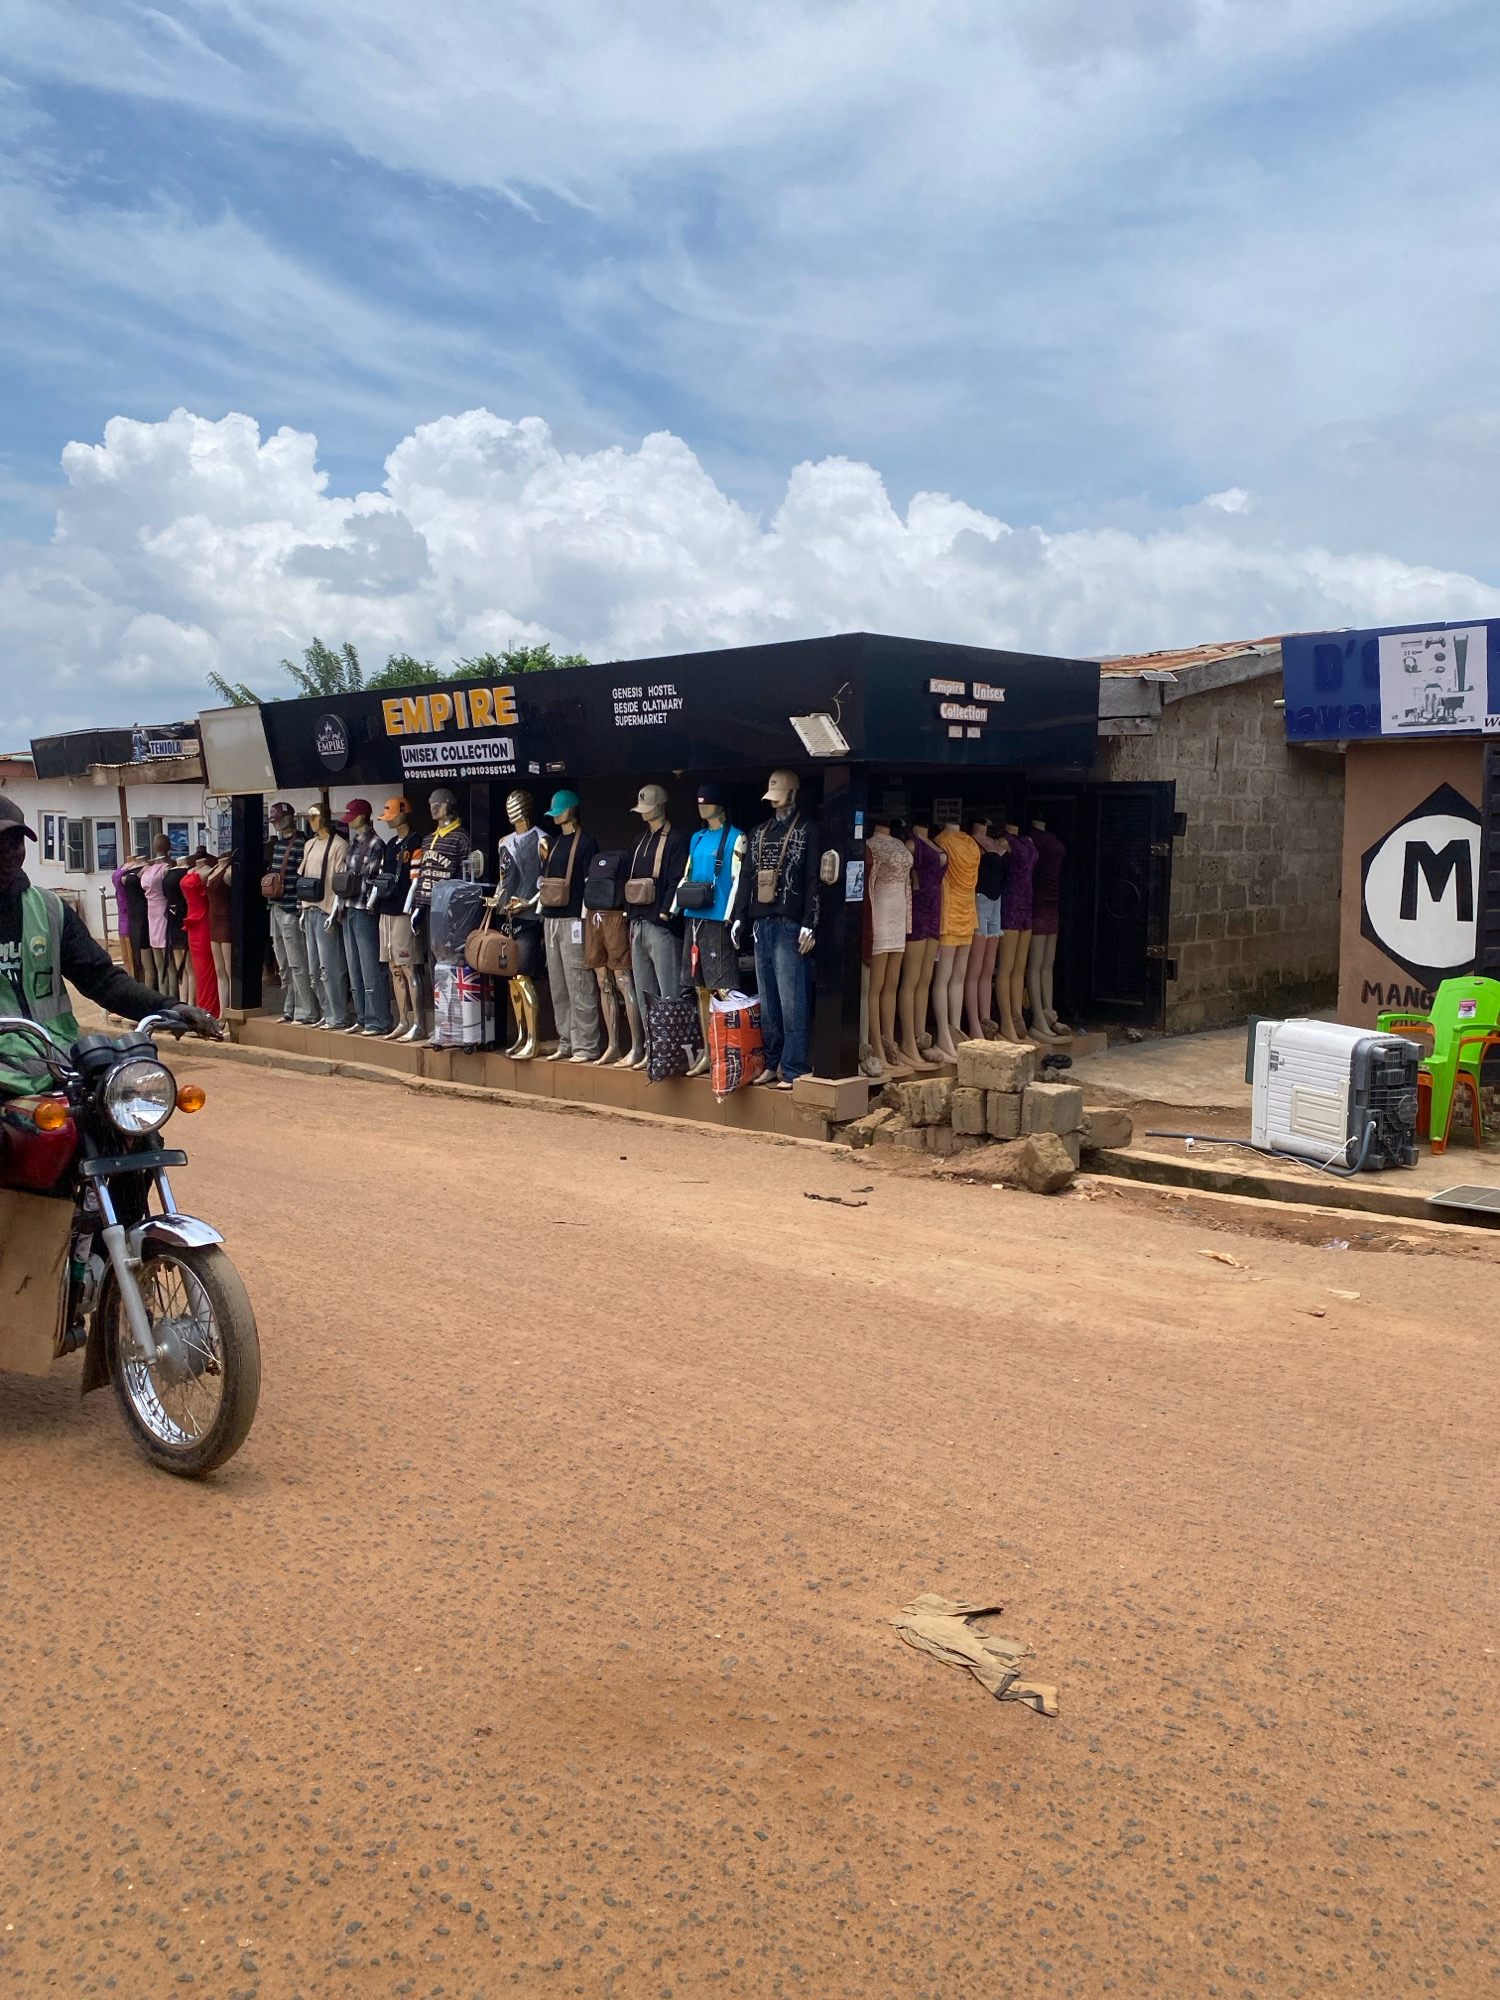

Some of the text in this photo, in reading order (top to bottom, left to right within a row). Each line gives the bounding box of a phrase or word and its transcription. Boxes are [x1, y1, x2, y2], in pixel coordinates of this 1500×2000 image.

[612, 684, 677, 699] GENESIS HOSTEL
[930, 679, 1005, 701] Empire Unisex
[382, 685, 519, 735] EMPIRE
[614, 698, 683, 713] BESIDE OLATMARY
[940, 702, 988, 721] Collection
[615, 713, 668, 726] SUPERMARKET
[151, 741, 182, 754] TENIOLA
[317, 740, 346, 752] EMPIRE
[402, 743, 509, 763] UNISEX COLLECTION
[1400, 839, 1474, 922] M
